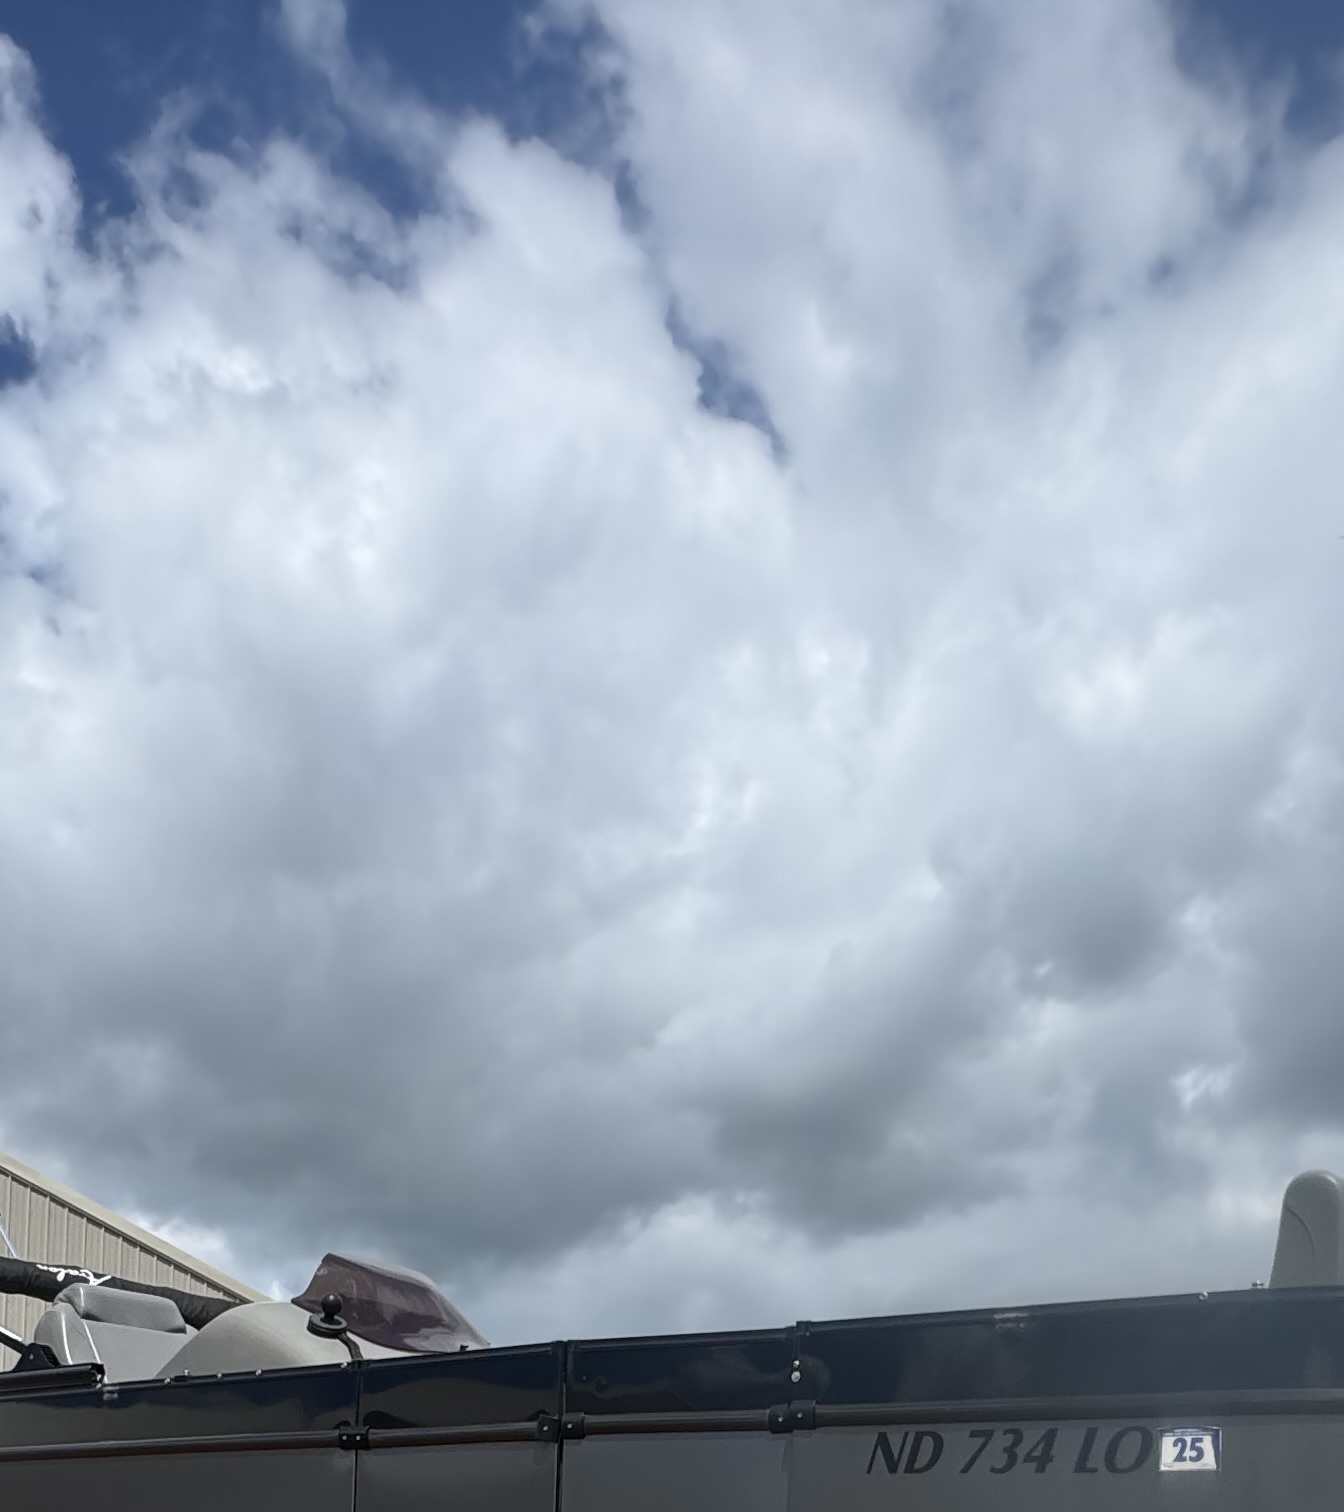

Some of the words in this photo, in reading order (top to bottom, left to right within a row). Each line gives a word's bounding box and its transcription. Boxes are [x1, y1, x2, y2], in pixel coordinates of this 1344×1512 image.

[866, 1431, 944, 1474] ND
[960, 1428, 1059, 1474] 734
[1073, 1426, 1154, 1474] LO
[1172, 1437, 1205, 1463] 25
